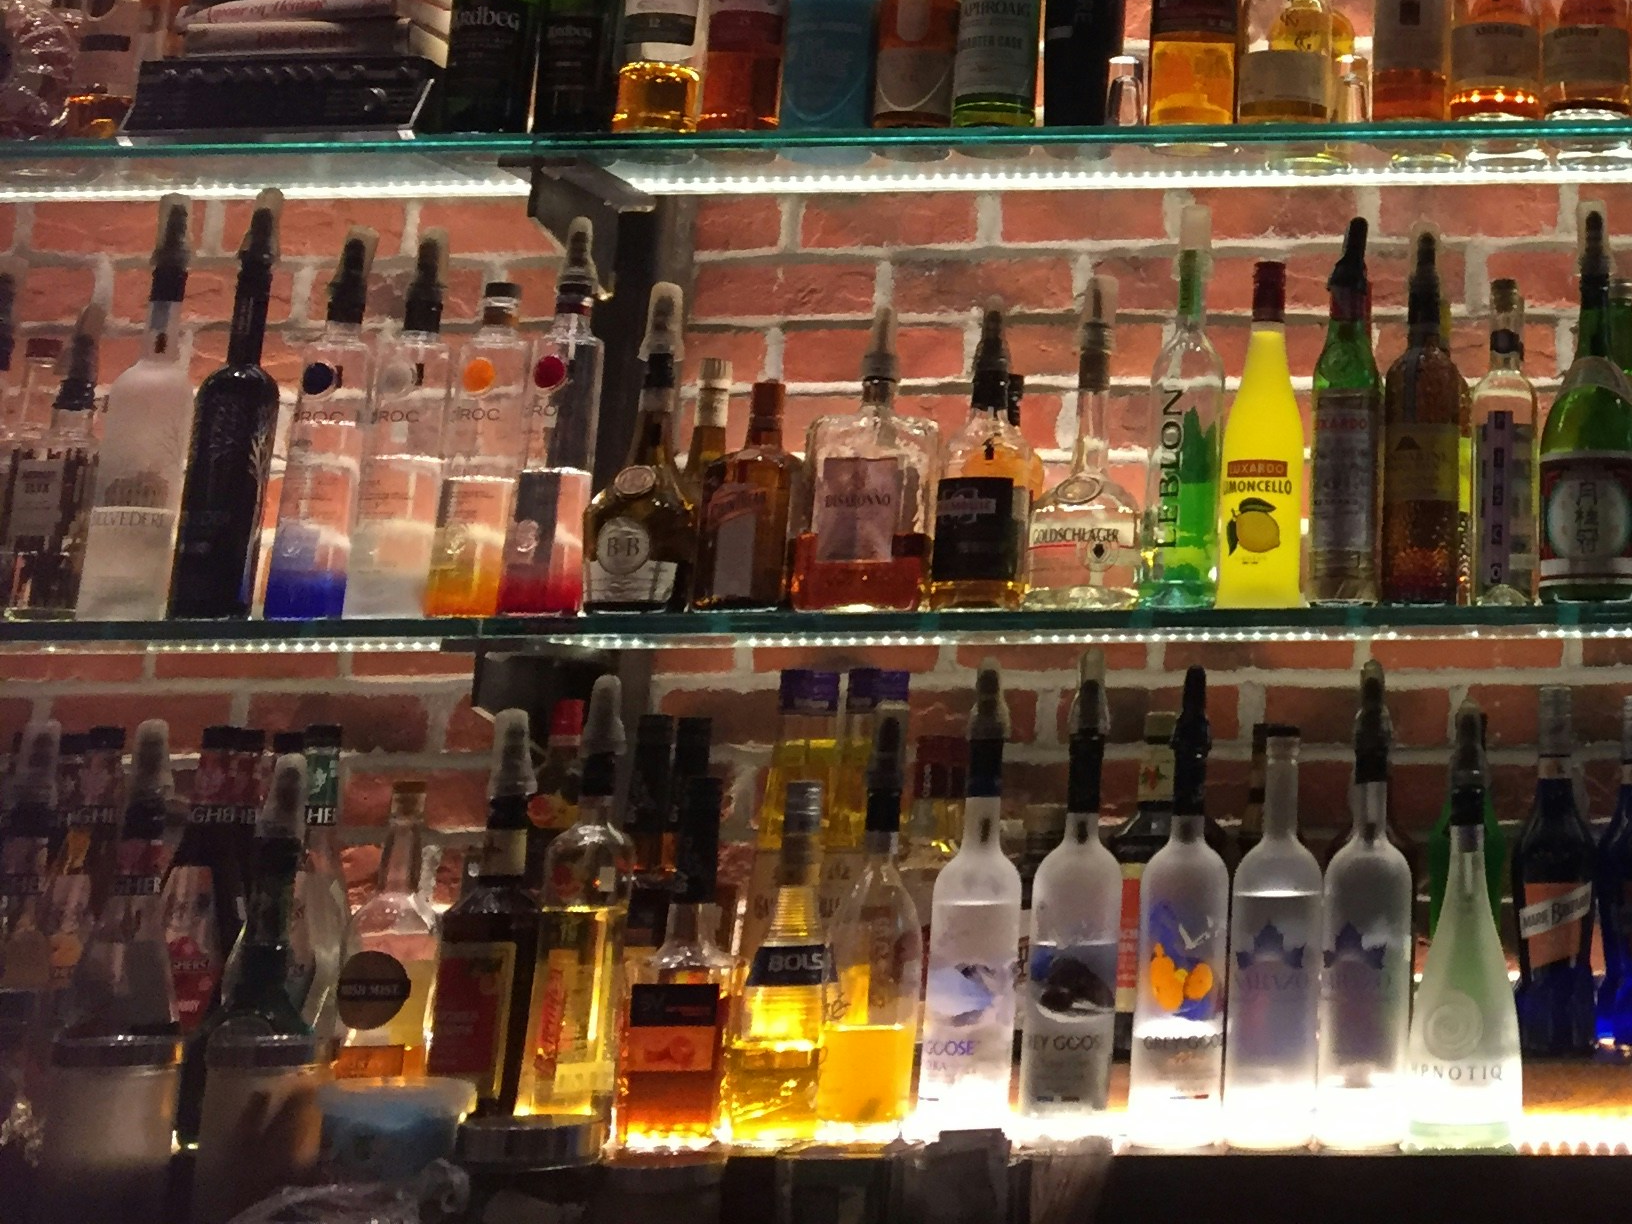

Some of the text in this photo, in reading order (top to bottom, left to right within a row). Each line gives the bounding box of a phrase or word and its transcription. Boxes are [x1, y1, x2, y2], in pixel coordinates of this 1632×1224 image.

[1314, 417, 1367, 430] XARDO
[1229, 463, 1286, 475] LUXARDO
[767, 951, 824, 972] BOLS
